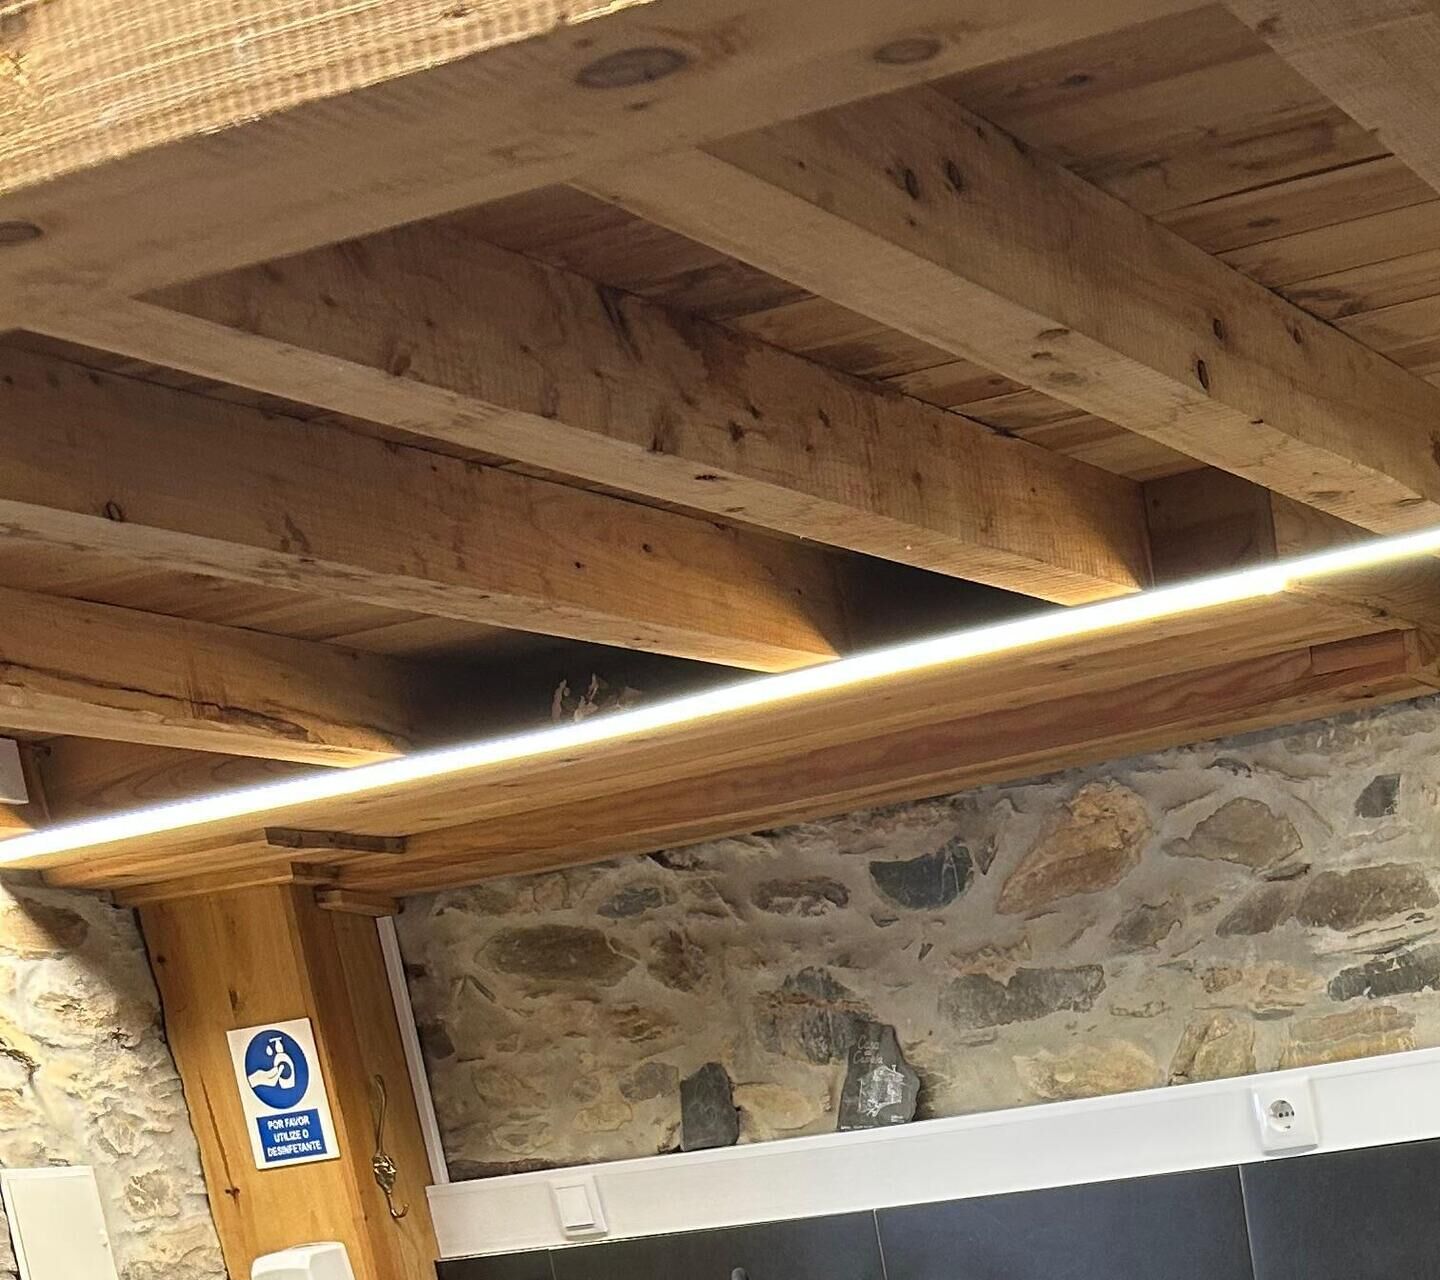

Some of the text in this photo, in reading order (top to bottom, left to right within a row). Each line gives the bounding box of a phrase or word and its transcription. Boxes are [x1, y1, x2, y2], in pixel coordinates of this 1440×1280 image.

[266, 1115, 311, 1131] POR FAVOR
[274, 1129, 309, 1143] UTILIZE O
[267, 1141, 322, 1157] DESINFETANTE
